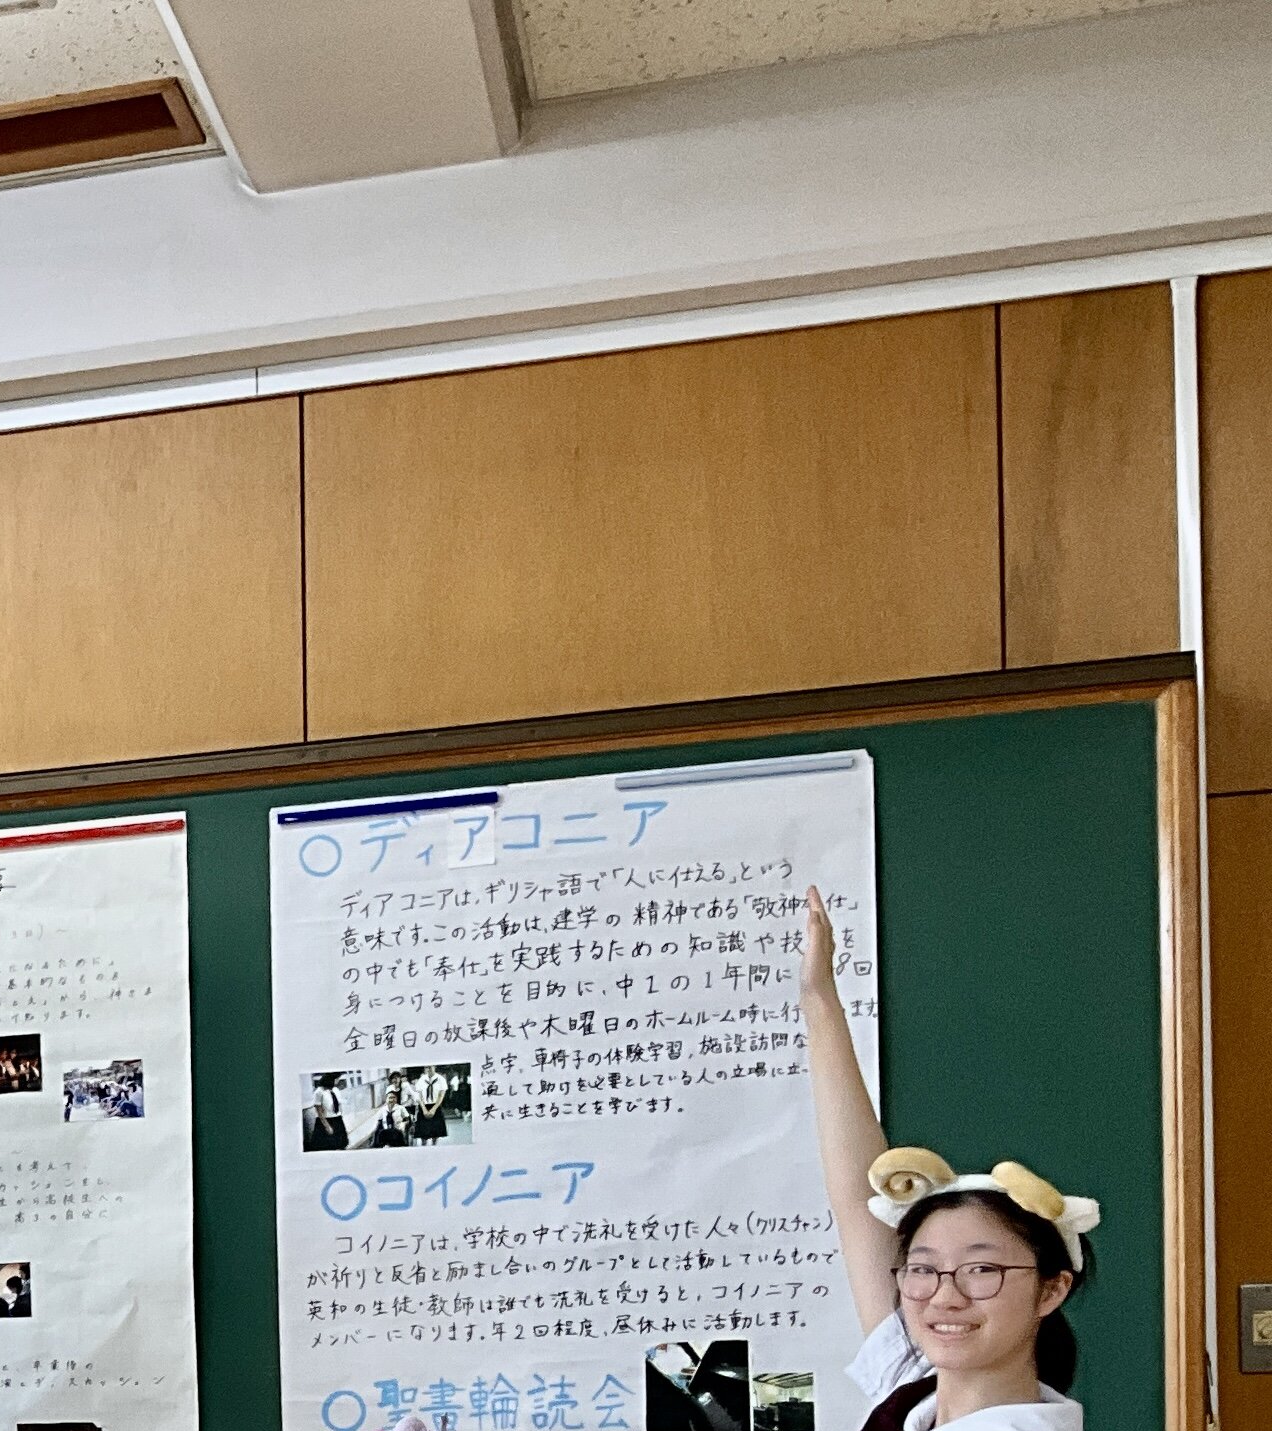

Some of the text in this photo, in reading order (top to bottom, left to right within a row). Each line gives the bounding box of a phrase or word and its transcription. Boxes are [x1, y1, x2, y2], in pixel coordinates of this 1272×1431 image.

[361, 800, 669, 872] ディアコニア
[341, 892, 859, 957] 意味です。この活動は、建学の精神である「敬神仕」
[342, 927, 856, 985] の中でも「奉仕」を実践するための知識や技を
[376, 1162, 595, 1211] コイノニア
[373, 1373, 636, 1431] 聖書輪読会
